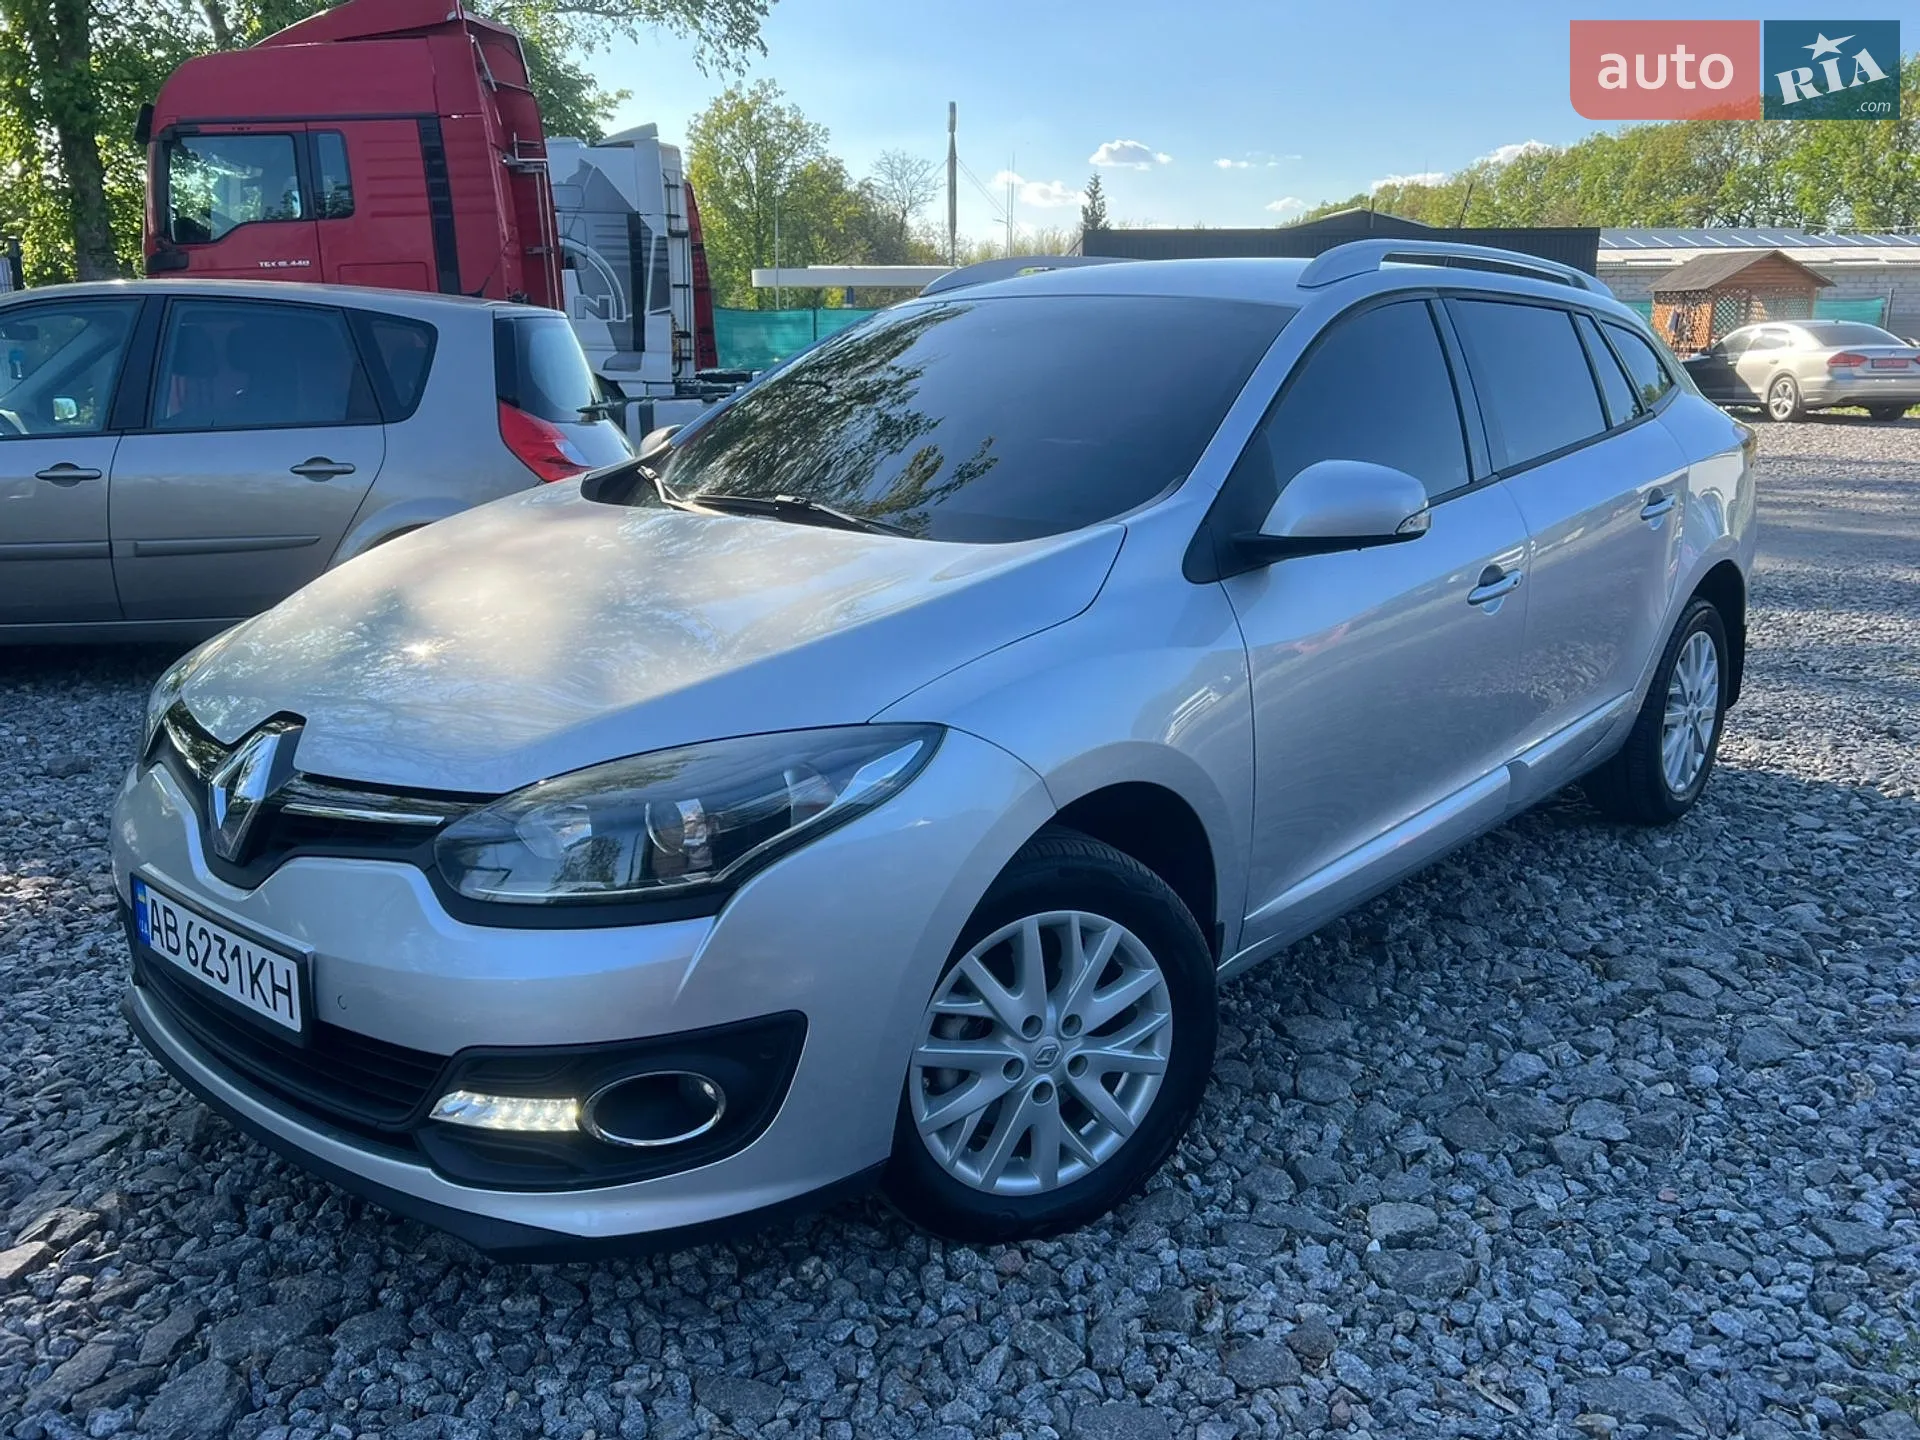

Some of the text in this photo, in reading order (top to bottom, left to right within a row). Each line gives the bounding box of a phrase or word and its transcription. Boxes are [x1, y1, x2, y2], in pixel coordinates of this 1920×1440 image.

[278, 260, 311, 268] .440
[150, 898, 294, 1020] AB 6231 KH
